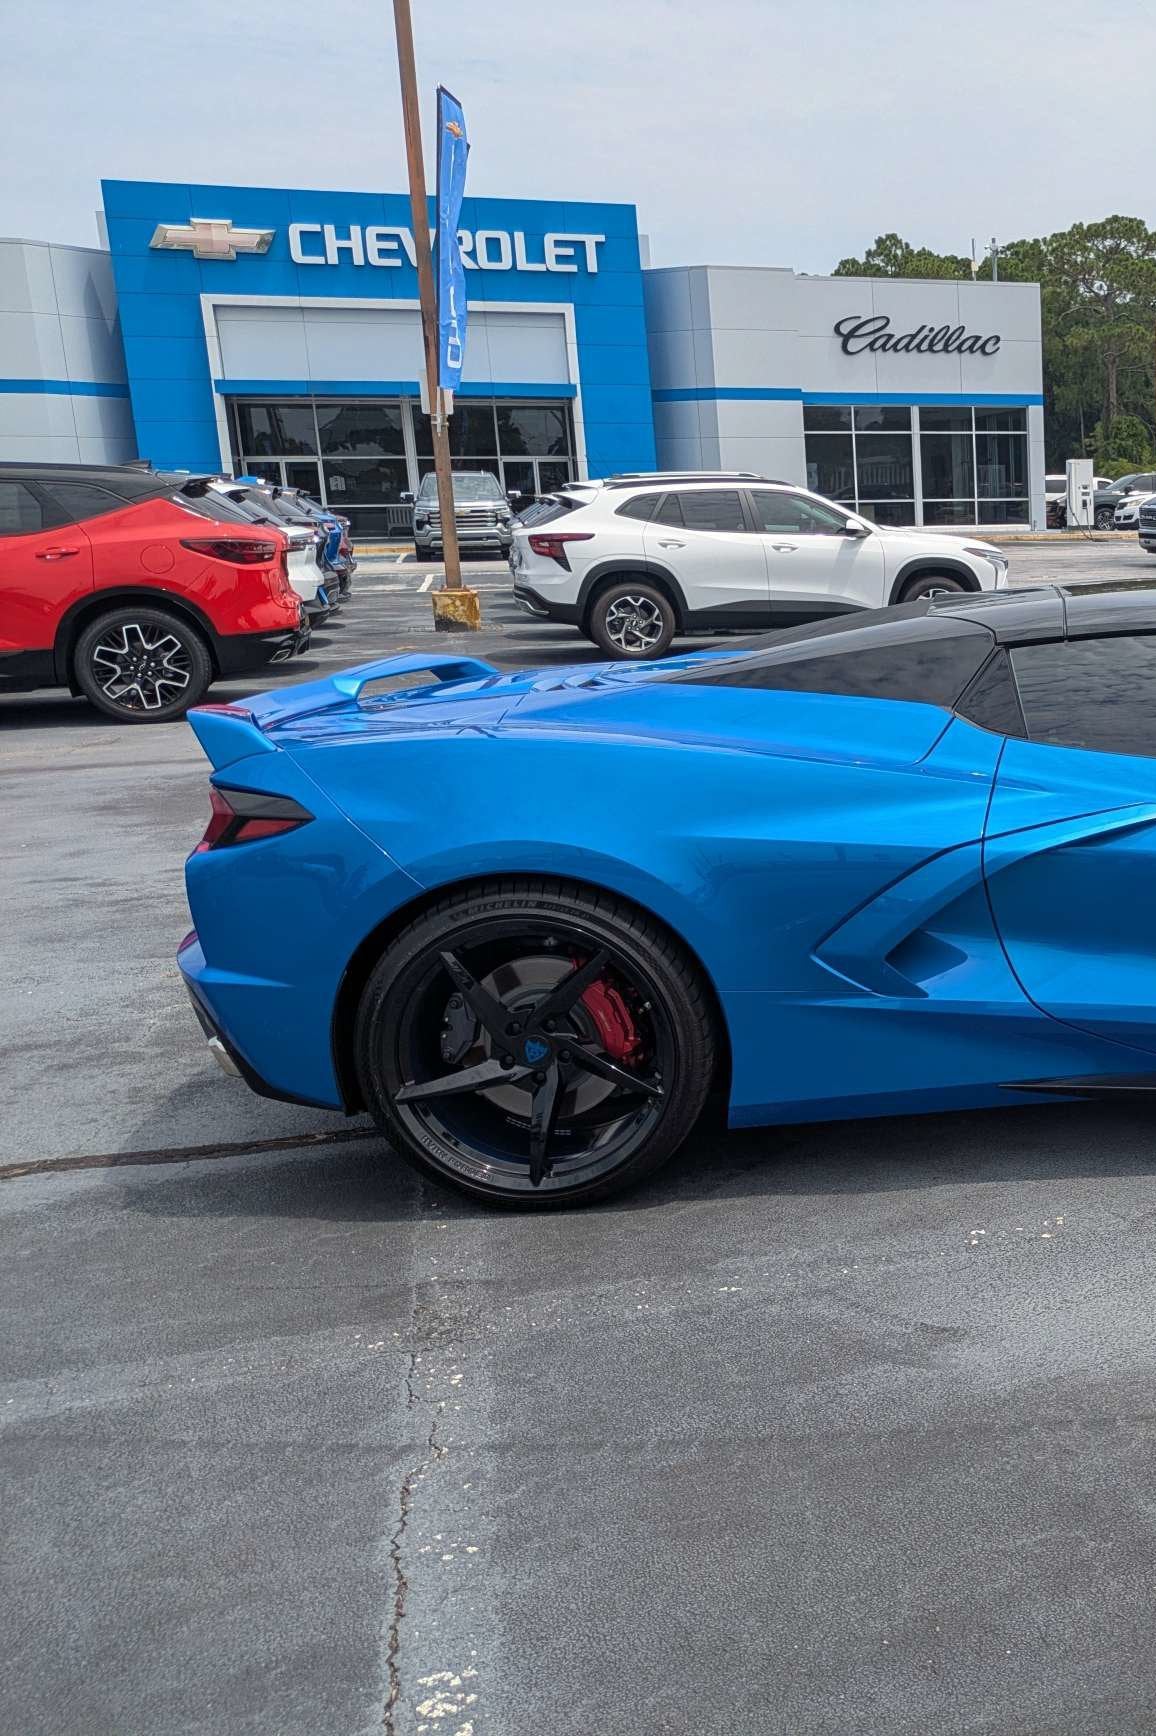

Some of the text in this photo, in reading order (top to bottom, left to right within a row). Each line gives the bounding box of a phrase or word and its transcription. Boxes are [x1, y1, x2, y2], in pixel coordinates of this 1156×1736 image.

[288, 223, 606, 273] CHEVROLET
[833, 315, 1001, 356] Cadillac
[467, 899, 538, 915] MICHELIN
